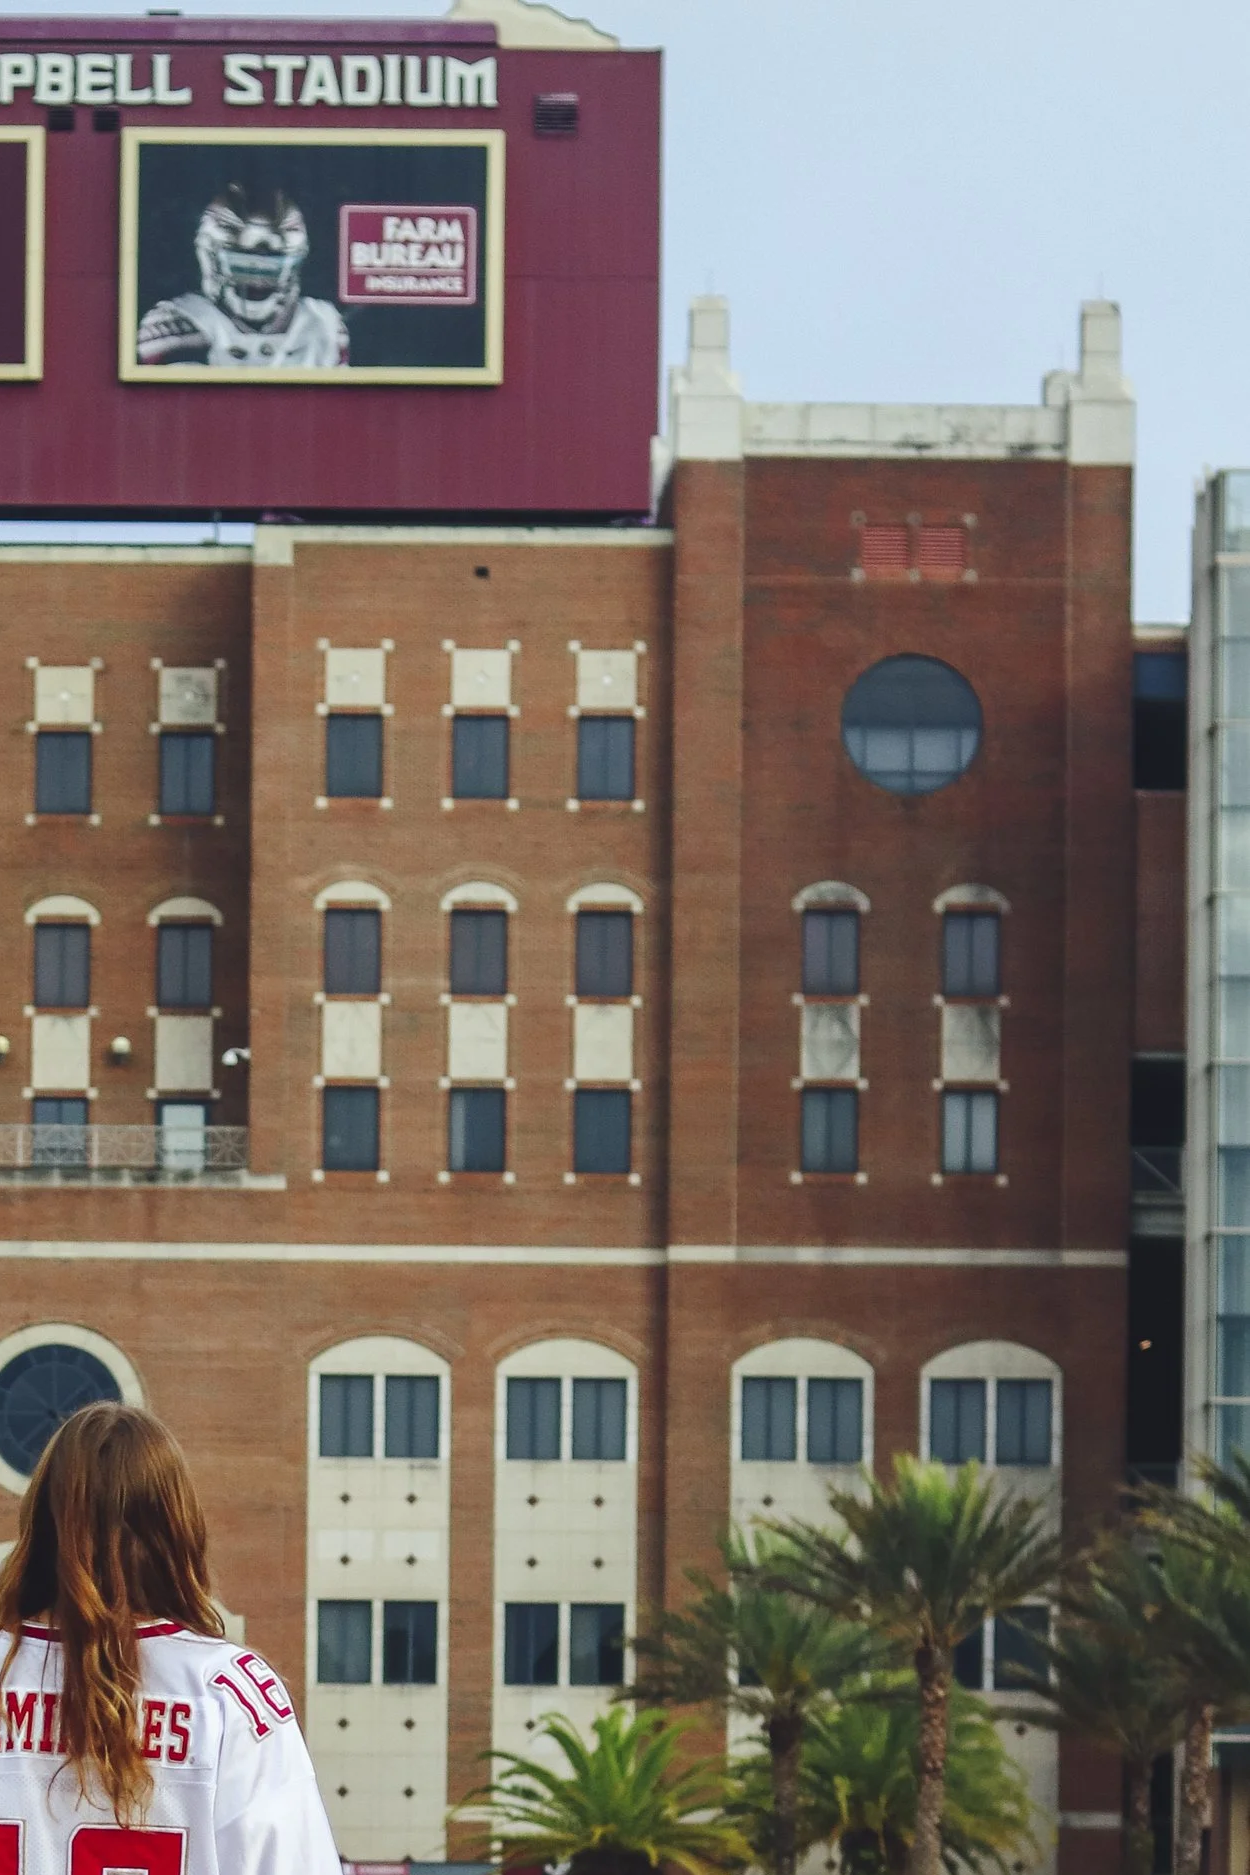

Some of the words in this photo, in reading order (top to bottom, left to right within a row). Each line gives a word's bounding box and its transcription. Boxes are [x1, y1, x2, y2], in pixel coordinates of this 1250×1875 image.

[222, 53, 499, 107] STADIUM
[382, 216, 465, 242] FARM
[351, 242, 466, 268] BUREAU
